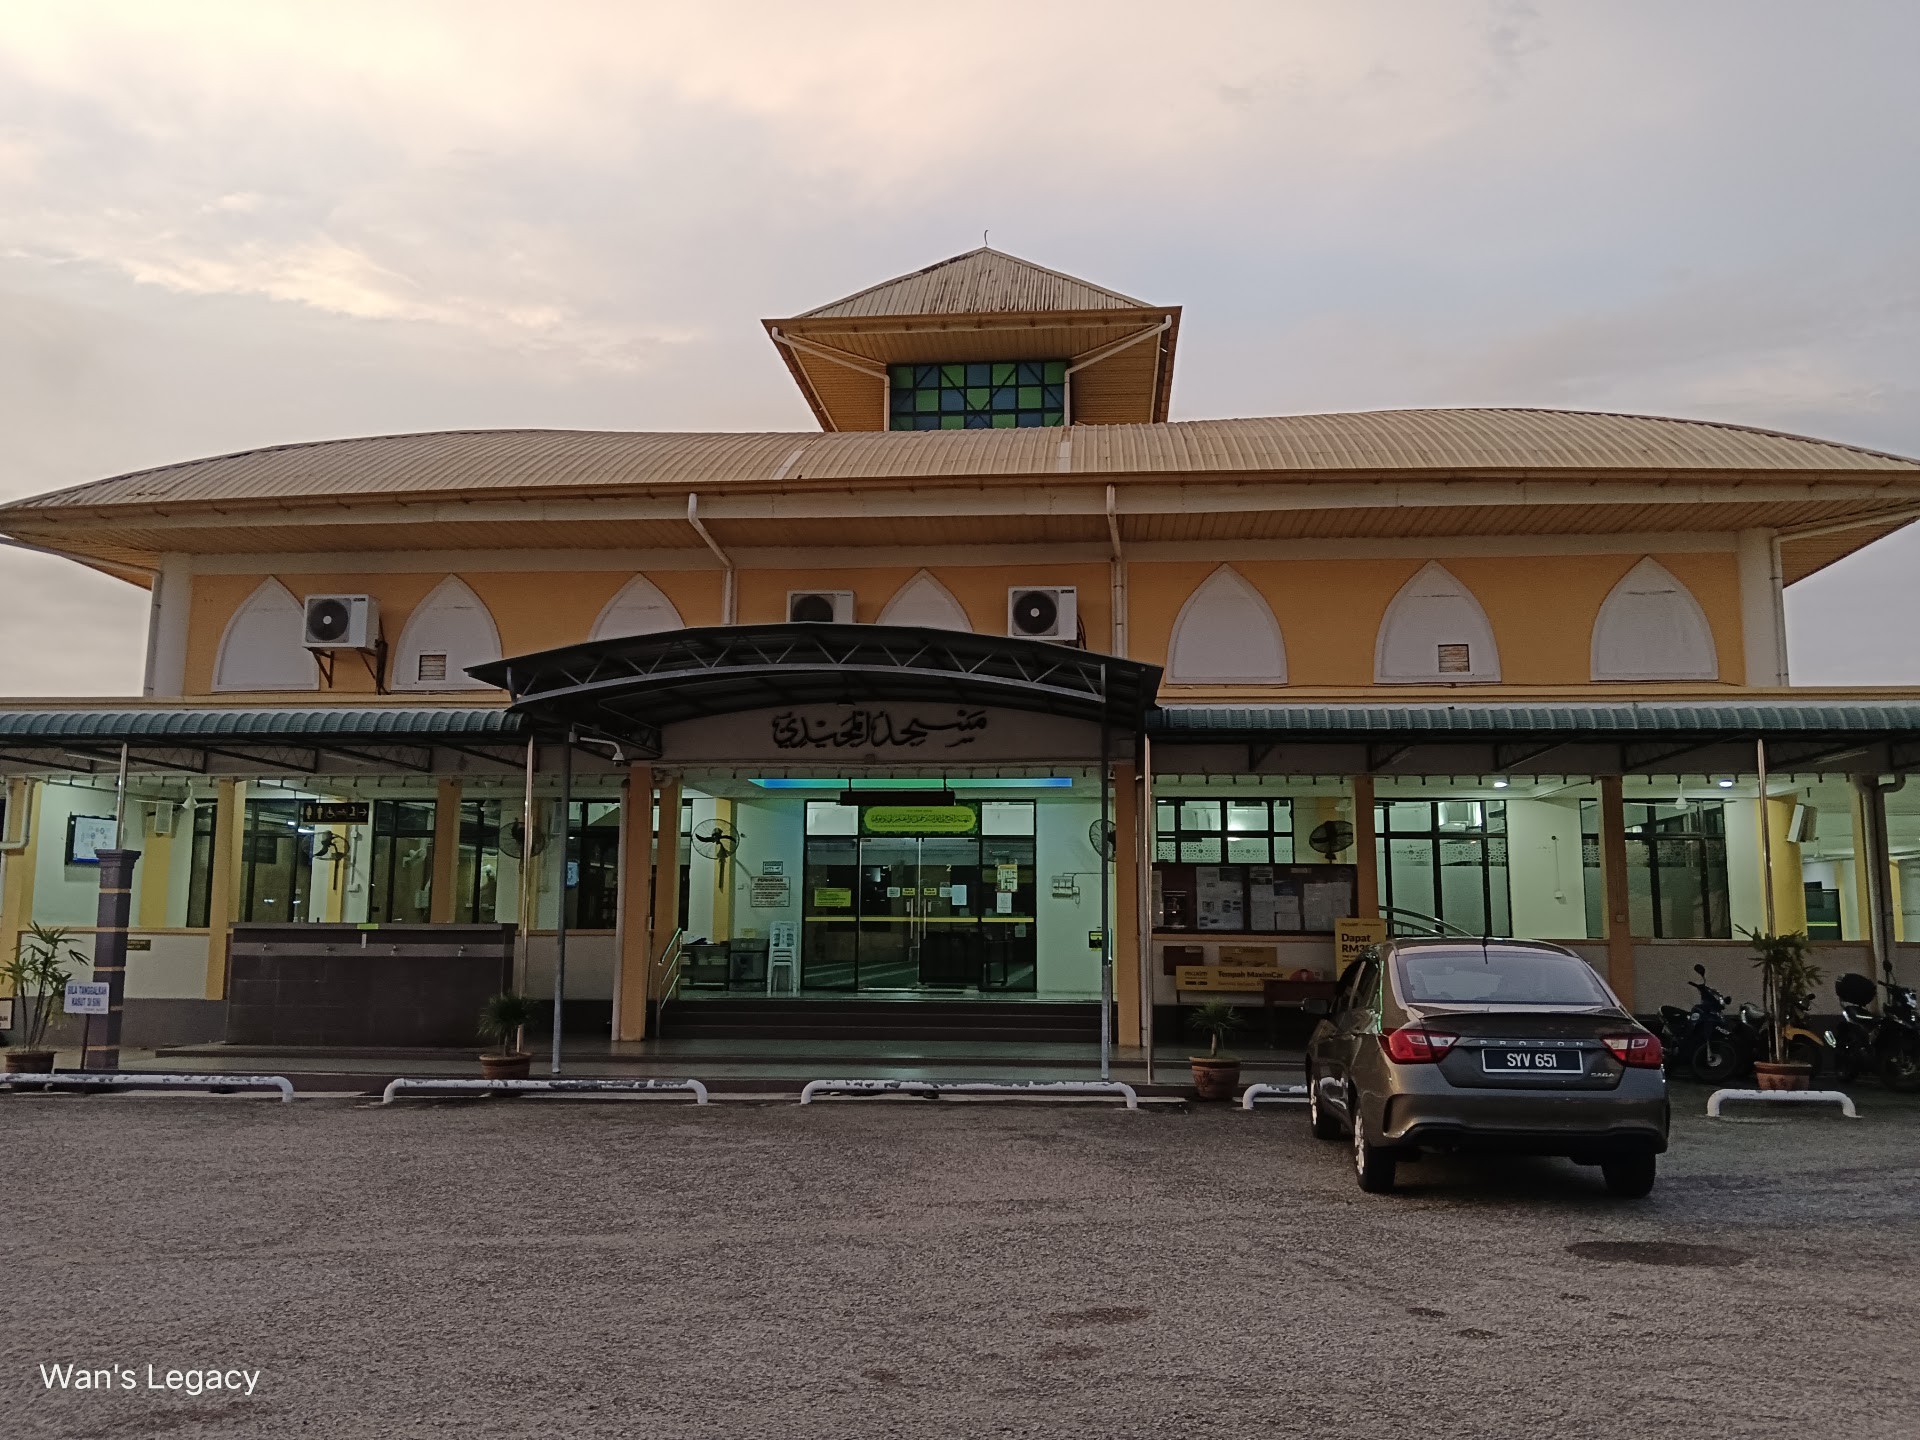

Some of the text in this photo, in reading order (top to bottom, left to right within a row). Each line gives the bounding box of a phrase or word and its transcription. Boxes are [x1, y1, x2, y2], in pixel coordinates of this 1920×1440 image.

[1341, 933, 1371, 944] Dapat
[1217, 970, 1246, 979] Tempah
[1479, 1040, 1584, 1048] PROTON
[1506, 1052, 1558, 1068] SYV 651
